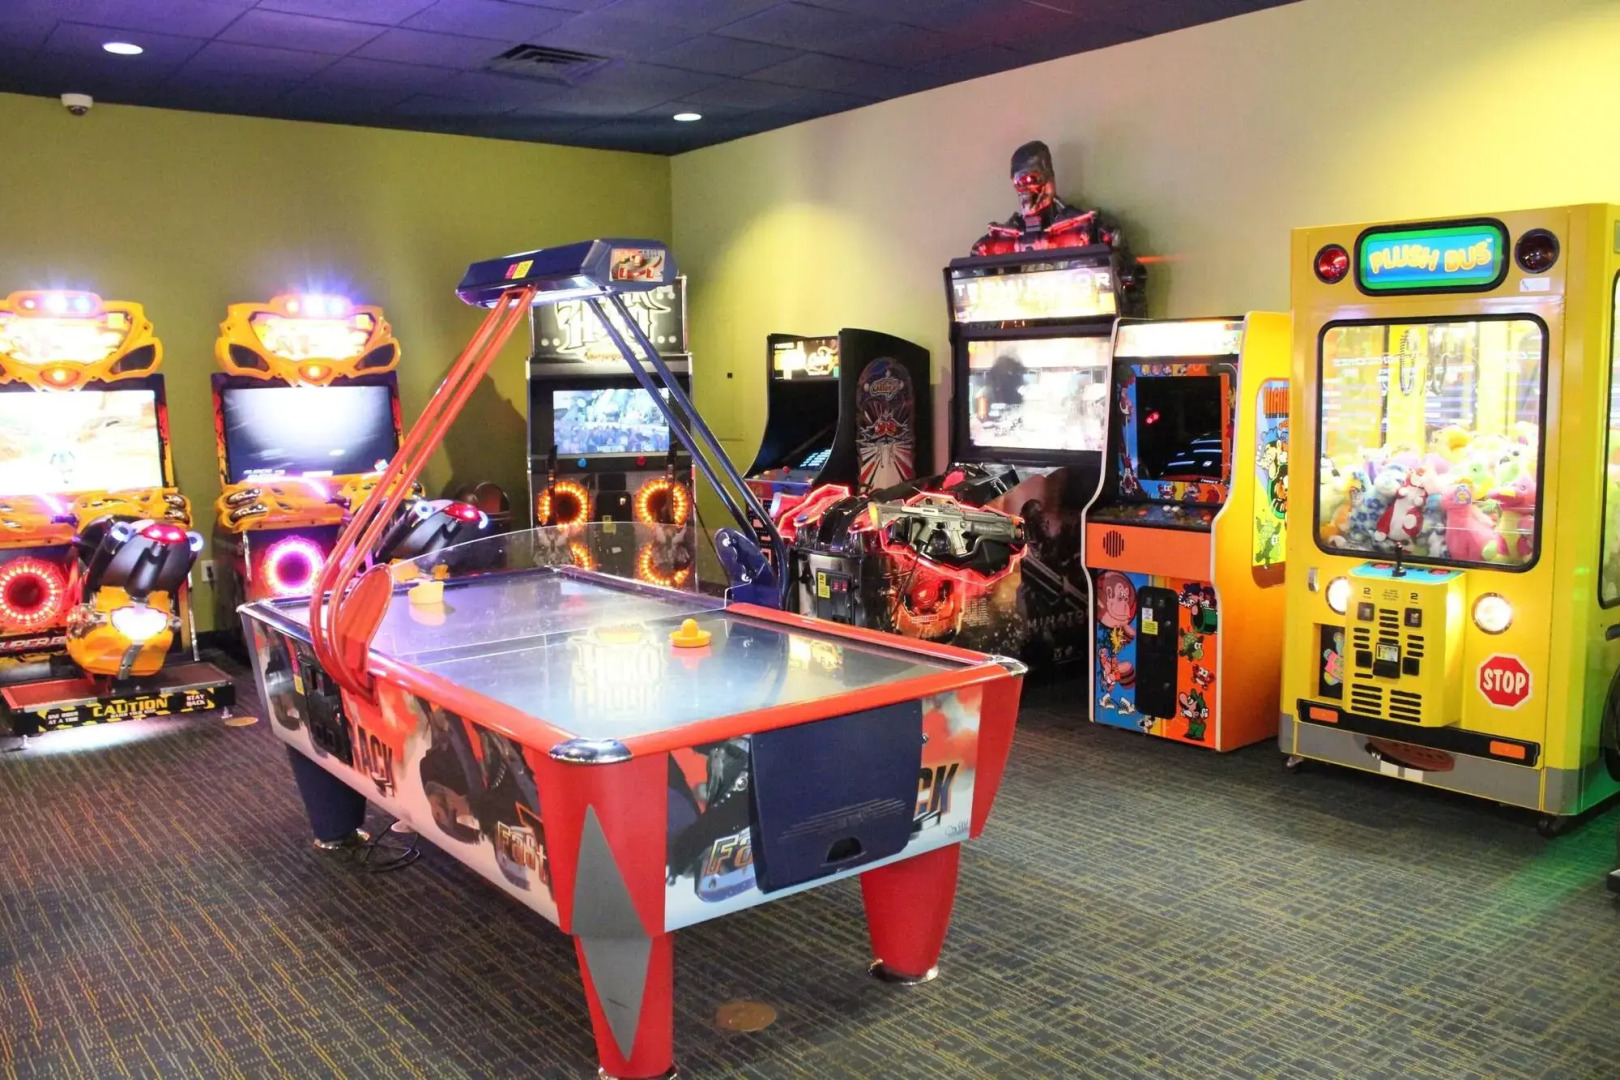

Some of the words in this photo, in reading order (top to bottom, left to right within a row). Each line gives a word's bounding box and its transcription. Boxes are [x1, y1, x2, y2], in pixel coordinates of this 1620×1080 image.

[1369, 244, 1440, 274] PLUSH
[1444, 241, 1492, 272] BUS
[1483, 668, 1526, 695] STOP
[93, 698, 168, 718] CAUTION
